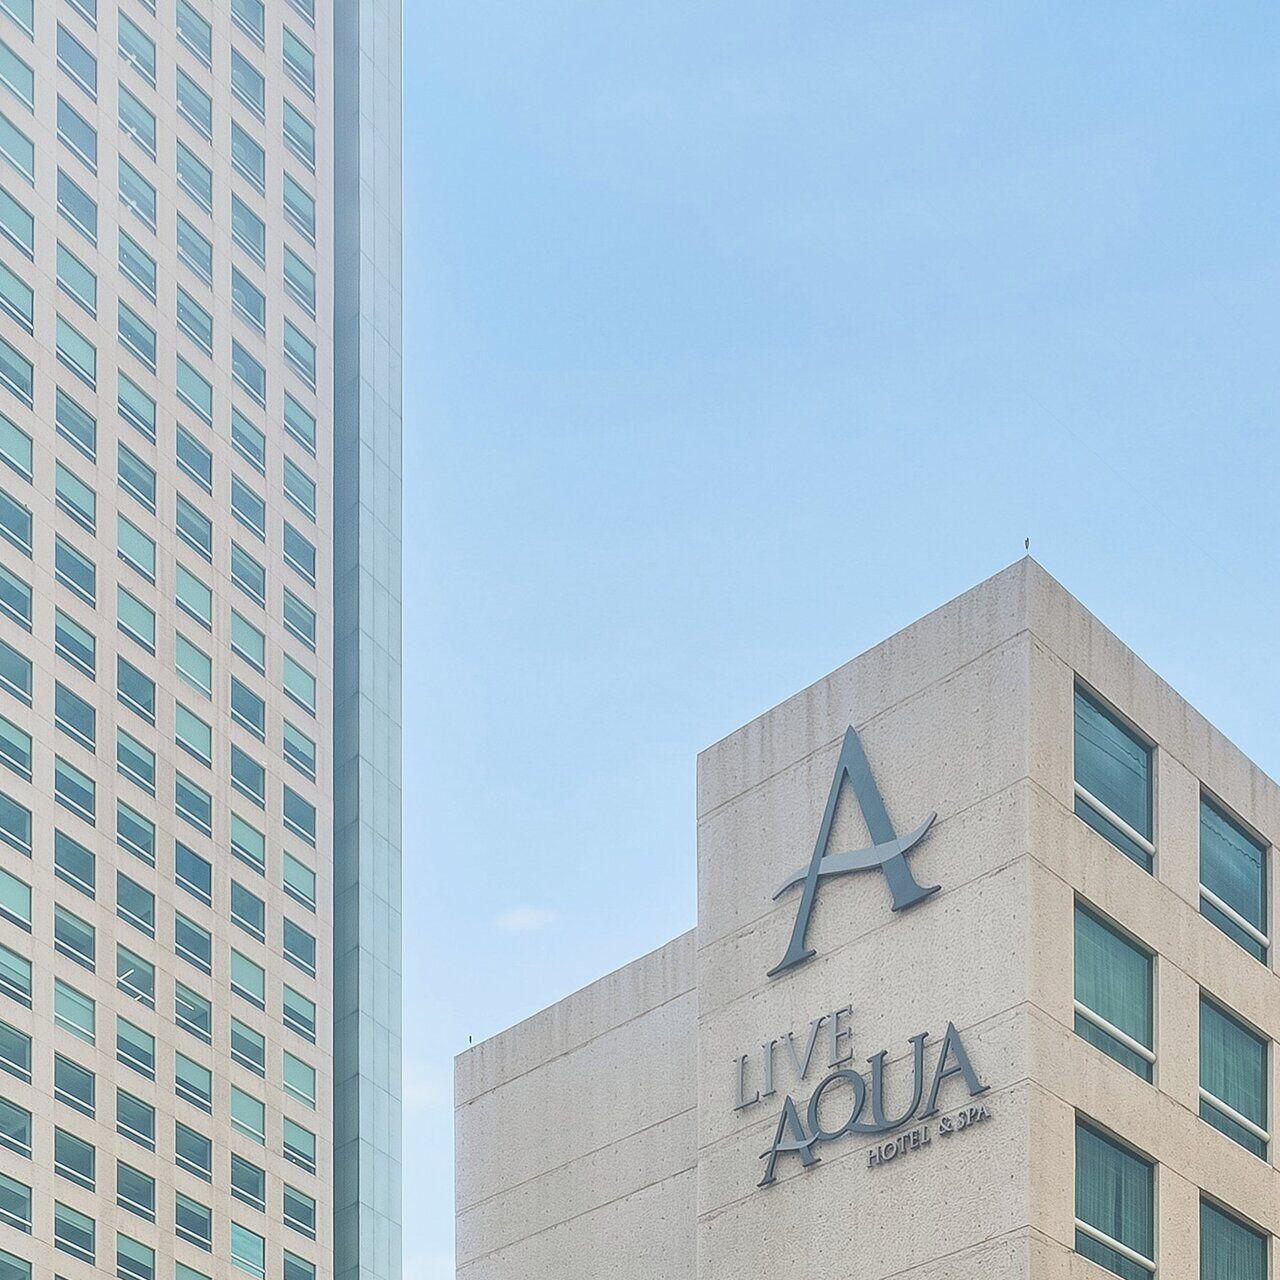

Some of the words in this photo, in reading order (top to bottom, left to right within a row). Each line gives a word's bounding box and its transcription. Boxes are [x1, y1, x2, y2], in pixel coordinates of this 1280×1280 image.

[733, 1004, 853, 1112] LIVE
[756, 1021, 991, 1188] AQUA
[865, 1130, 932, 1169] HOTEL
[938, 1117, 953, 1137] &
[956, 1105, 992, 1131] SPA
